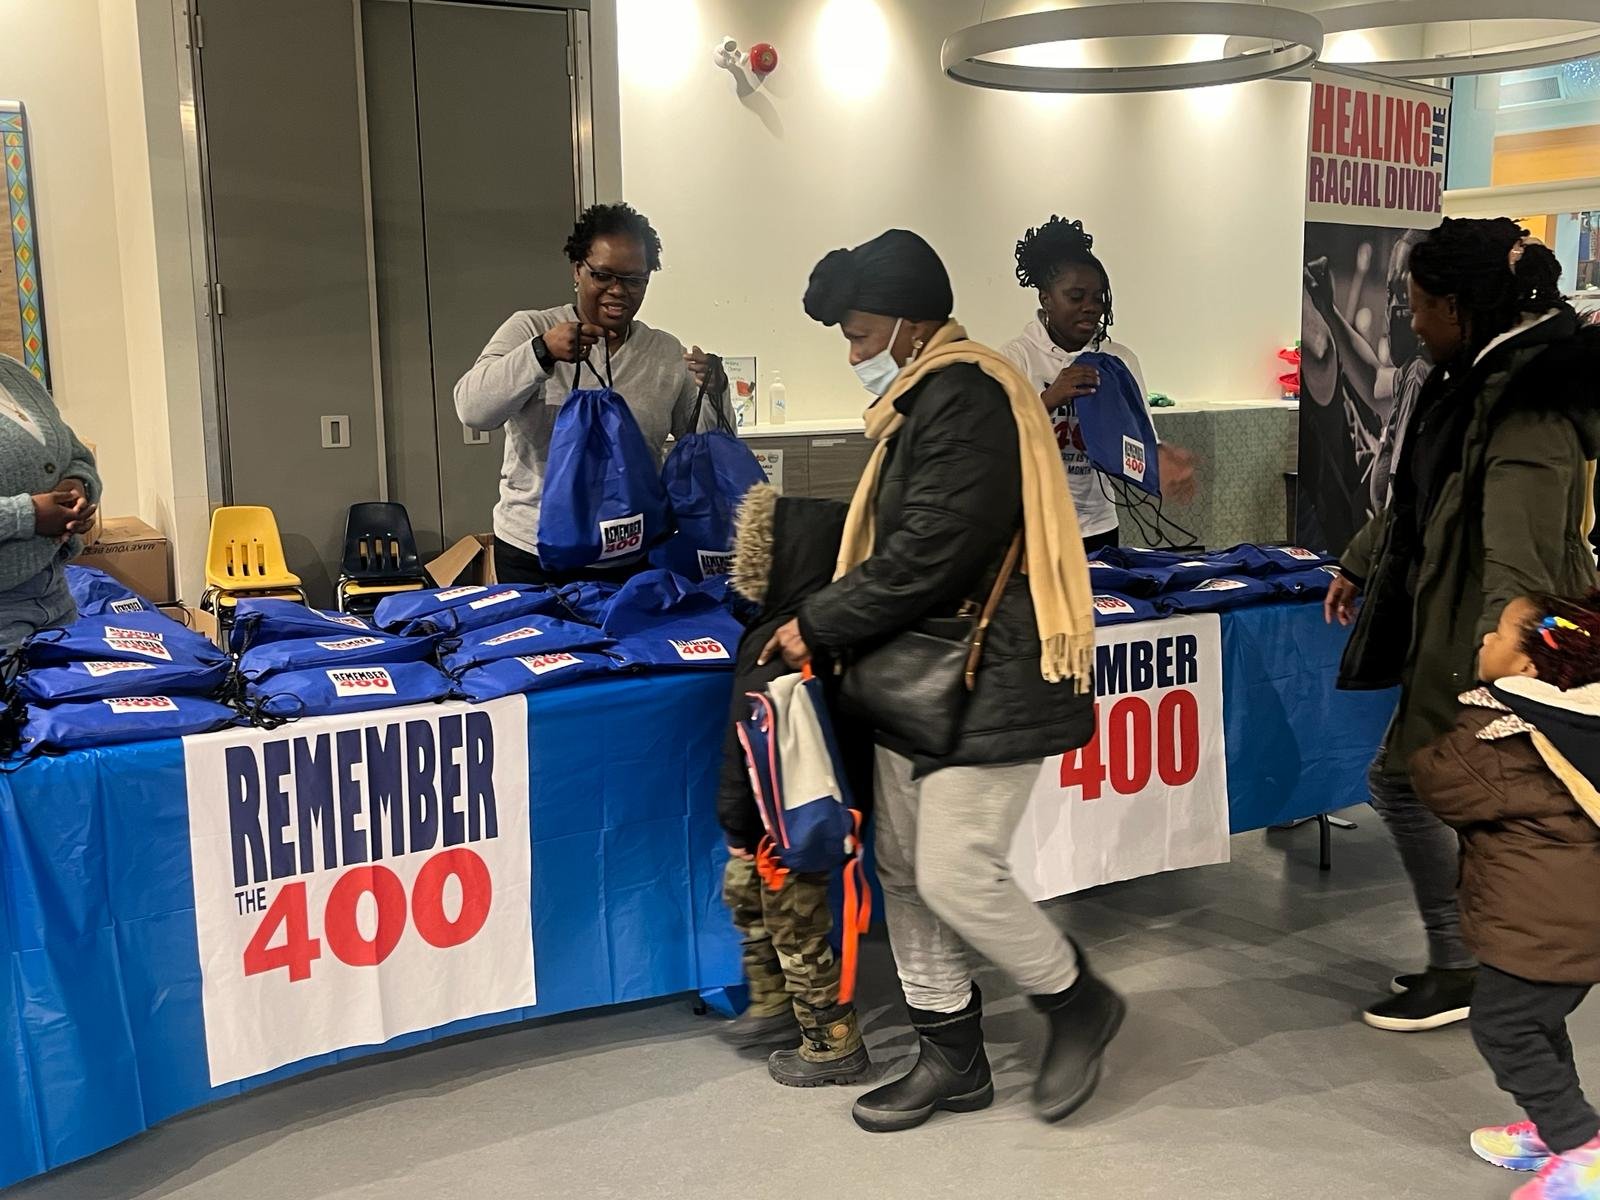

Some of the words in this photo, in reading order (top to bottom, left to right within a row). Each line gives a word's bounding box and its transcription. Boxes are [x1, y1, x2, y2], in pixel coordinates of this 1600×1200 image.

[1311, 83, 1431, 167] HEALING
[1430, 106, 1446, 167] THE
[1309, 157, 1380, 207] RACIAL
[1384, 165, 1442, 213] DIVIDE
[1125, 458, 1143, 473] 400
[604, 520, 641, 544] REMEMBER
[106, 545, 130, 554] YOUR
[130, 543, 156, 552] MAKE
[532, 654, 573, 668] 400
[682, 644, 722, 655] 400
[332, 670, 388, 682] REMEMBER
[340, 678, 389, 687] 400
[1060, 689, 1200, 801] 400
[224, 710, 498, 888] REMEMBER
[234, 887, 267, 916] THE
[243, 847, 493, 983] 400
